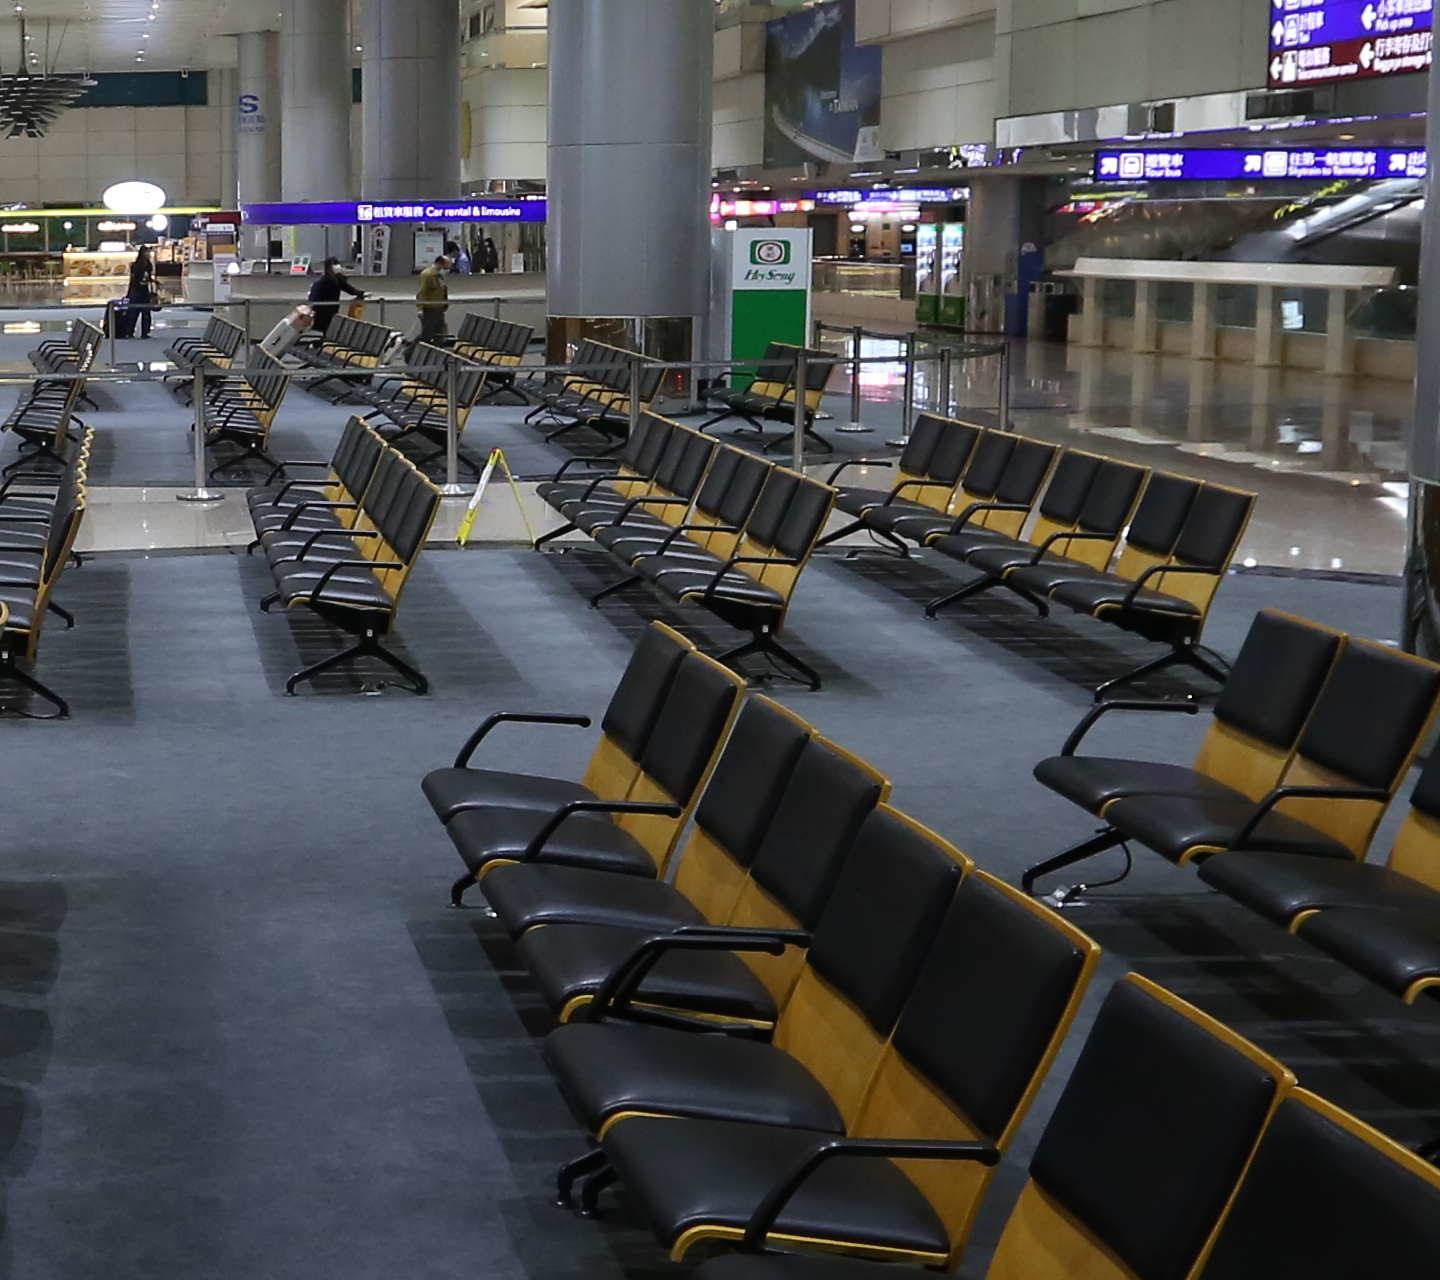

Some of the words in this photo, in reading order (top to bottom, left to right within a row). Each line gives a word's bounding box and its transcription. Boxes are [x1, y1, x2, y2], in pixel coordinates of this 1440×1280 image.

[1145, 167, 1164, 178] Tour
[1165, 167, 1182, 178] bus
[1288, 167, 1324, 179] Skytrain
[1325, 167, 1332, 177] to
[1333, 166, 1369, 177] Terminal
[426, 206, 443, 217] Car
[445, 206, 471, 217] rental
[472, 206, 481, 217] &
